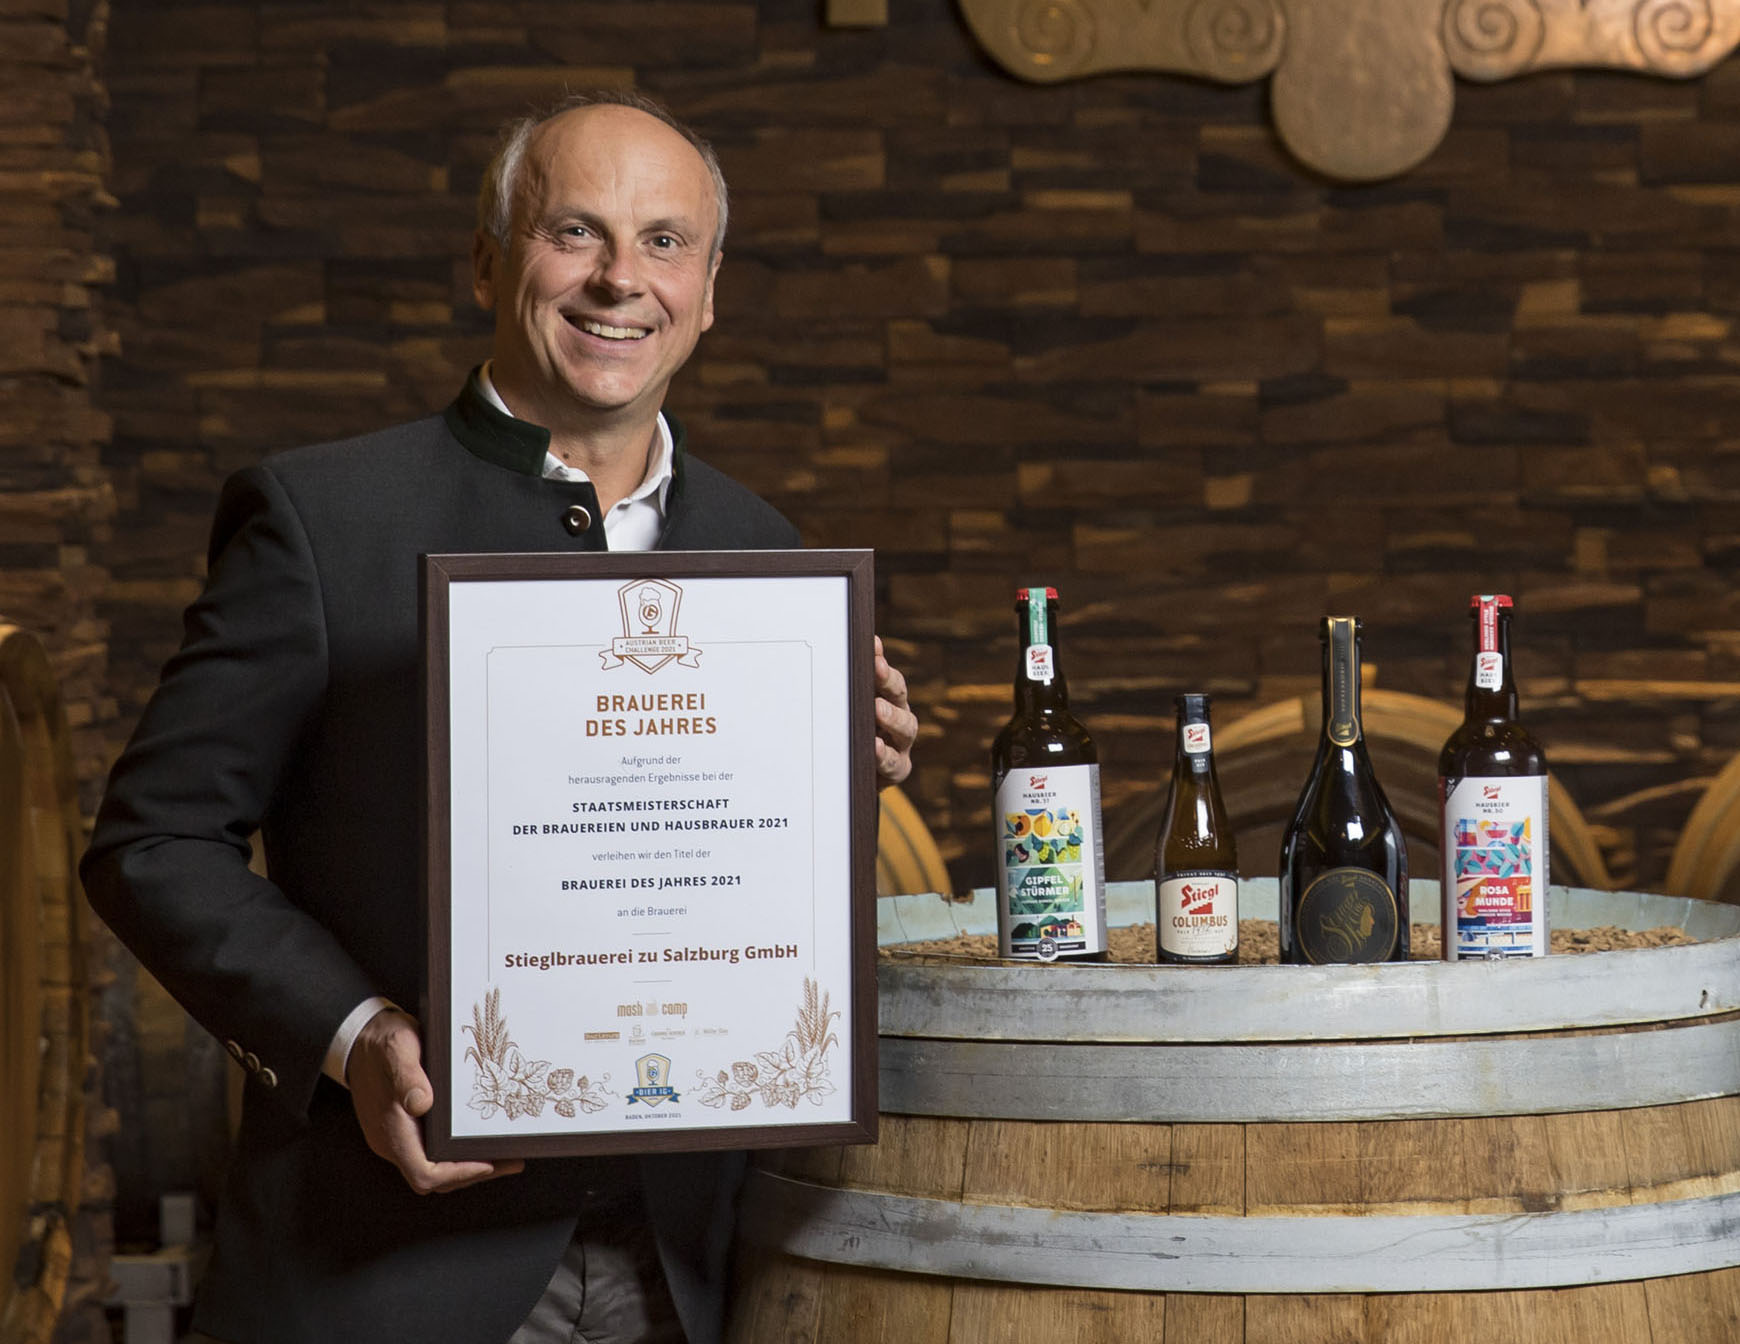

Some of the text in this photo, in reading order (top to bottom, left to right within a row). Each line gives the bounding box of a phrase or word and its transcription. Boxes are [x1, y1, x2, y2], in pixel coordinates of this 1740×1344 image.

[625, 638, 657, 646] AUSTRIAN
[596, 693, 705, 712] BRAUEREI
[586, 716, 717, 737] DES JAHRES
[621, 755, 682, 767] Aufgrund der
[568, 771, 734, 786] herausragenden Ergebnisse bei der
[572, 798, 730, 813] STAATSMEISTERSCHAFT
[512, 817, 789, 835] DER BRAUEREIEN UND HAUSBRAUER 2021
[592, 848, 712, 861] verleihen wir den Titel der
[561, 875, 742, 890] BRAUEREI DES JAHRES 2021
[1025, 875, 1064, 886] GIPFEL
[1021, 885, 1070, 897] STÜRMER
[1181, 884, 1219, 908] Stiegl
[1479, 886, 1510, 895] ROSA
[1475, 896, 1514, 906] MUNDE
[616, 906, 688, 917] an die Brauerei
[1172, 915, 1229, 928] COLUMBUS
[504, 944, 798, 971] Stieglbrauerei zu Salzburg GmbH
